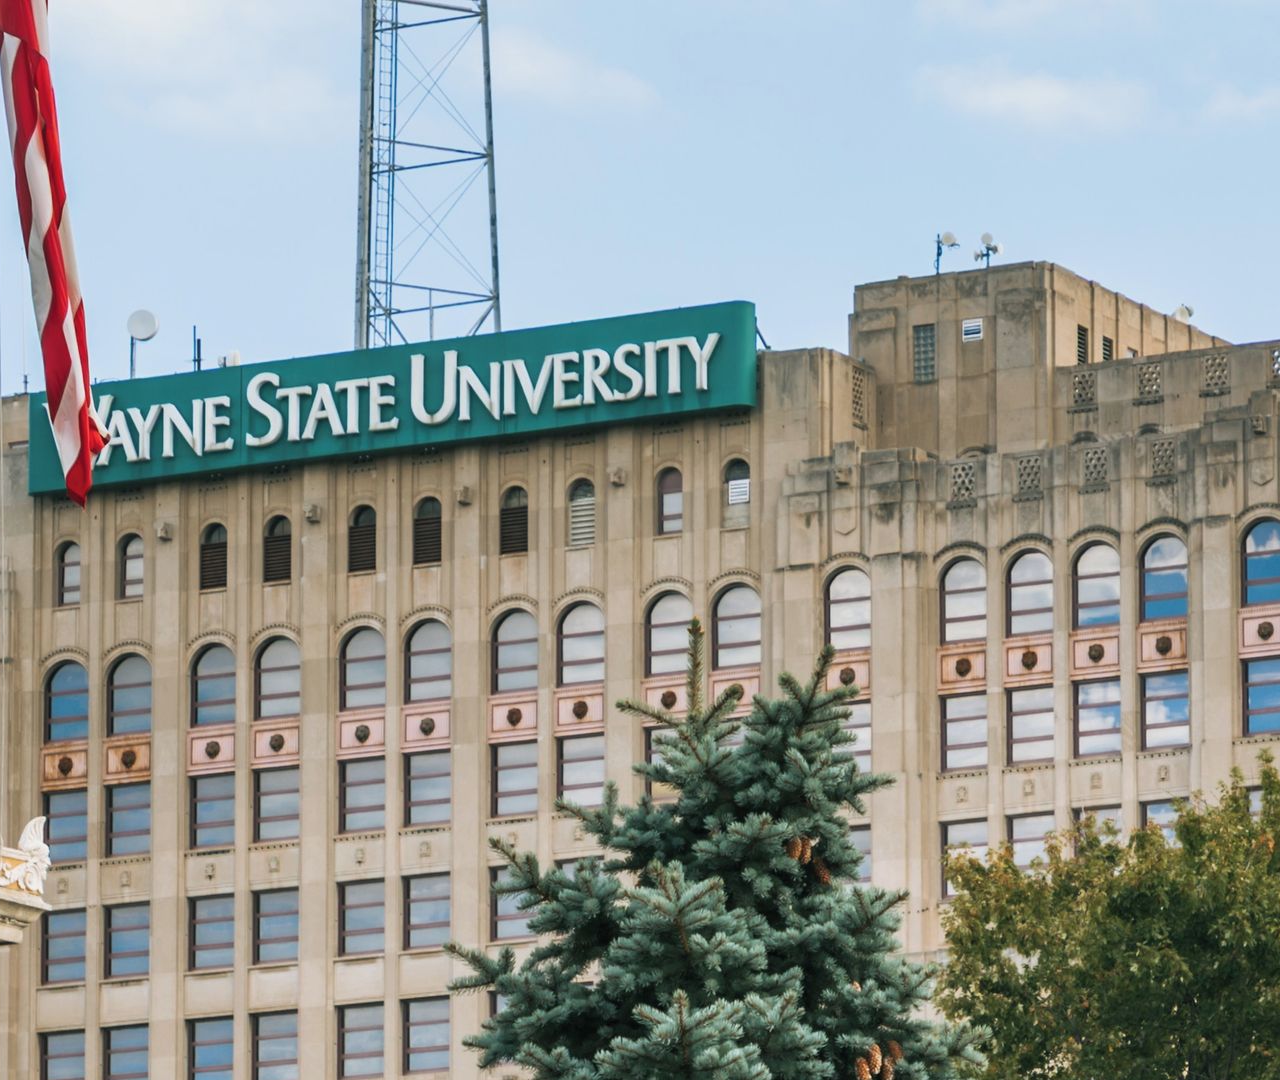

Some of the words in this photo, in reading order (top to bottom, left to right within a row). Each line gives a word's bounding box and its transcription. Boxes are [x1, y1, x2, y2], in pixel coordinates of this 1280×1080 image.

[42, 394, 234, 471] AYNE
[245, 372, 398, 448] STATE
[410, 332, 721, 425] UNIVERSITY
